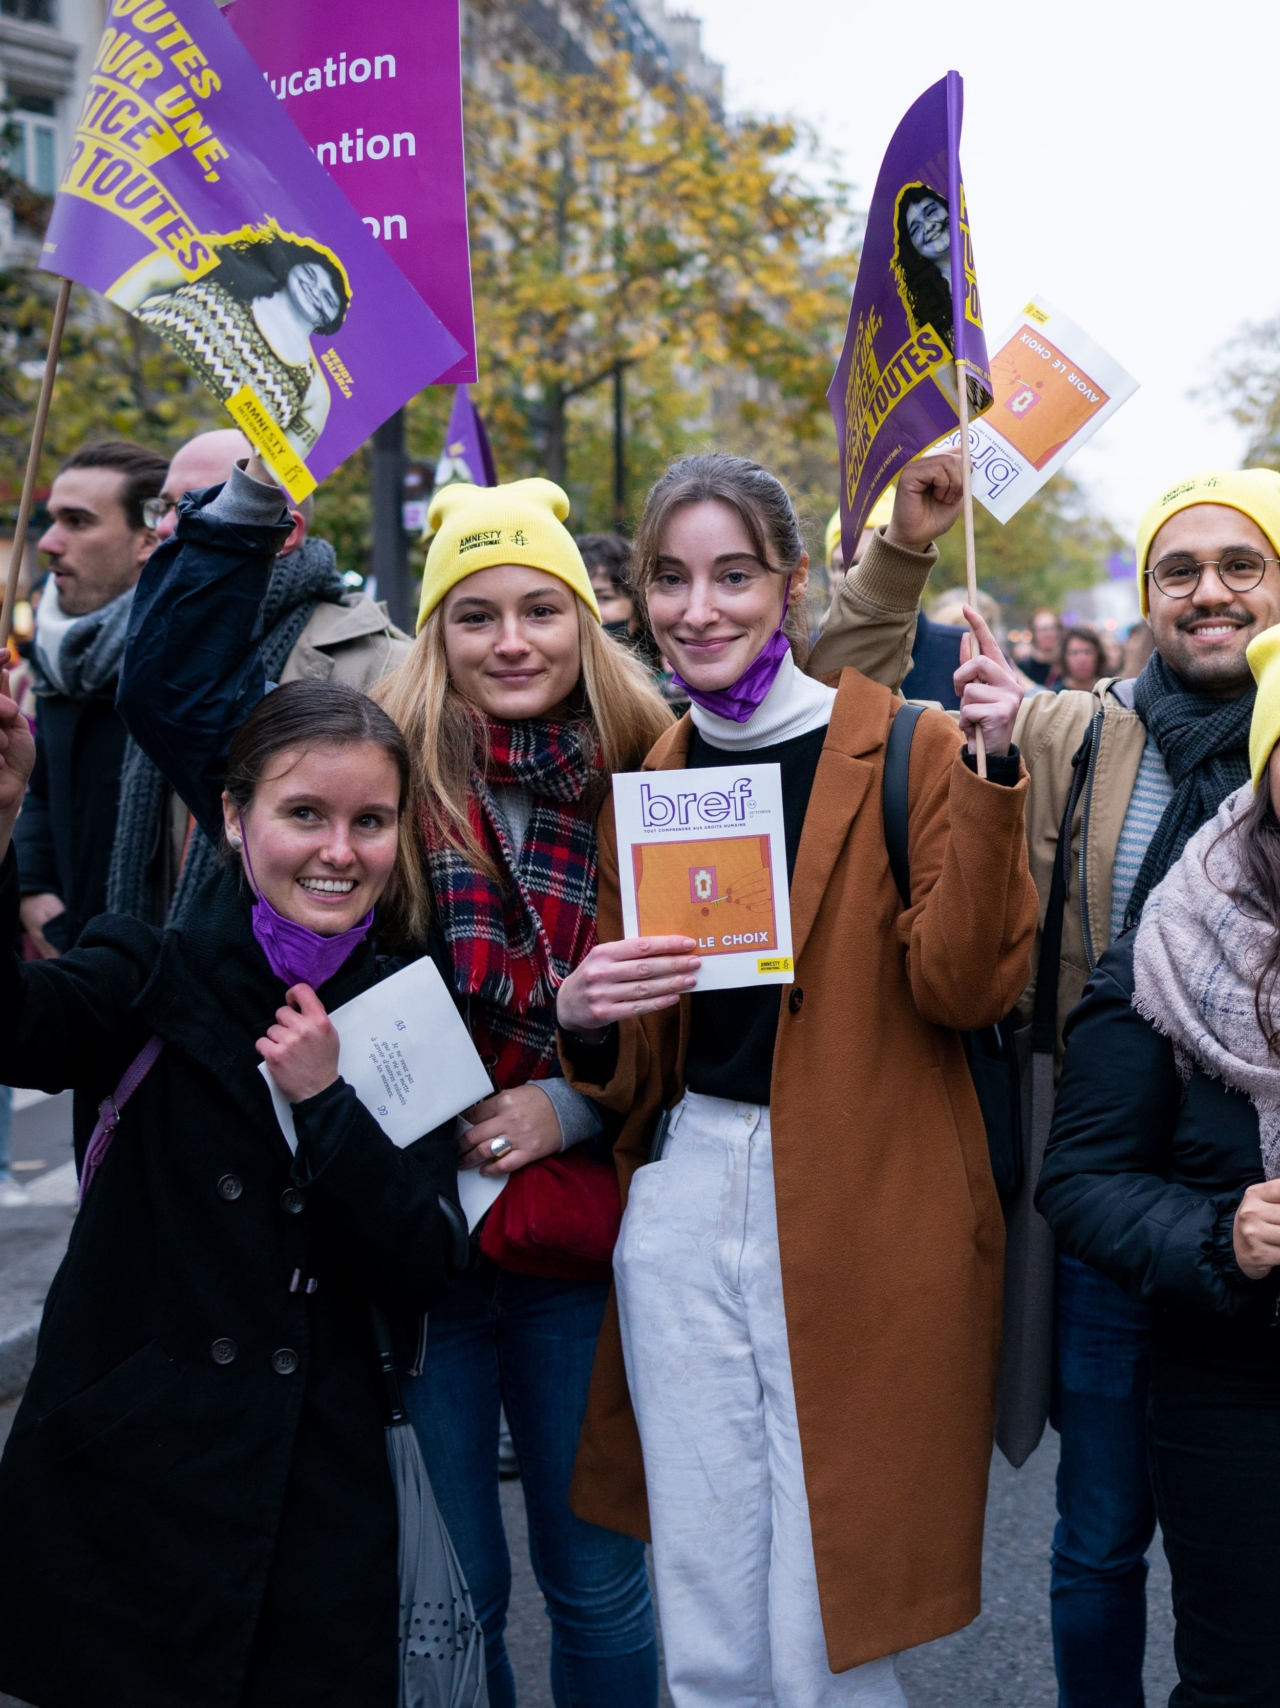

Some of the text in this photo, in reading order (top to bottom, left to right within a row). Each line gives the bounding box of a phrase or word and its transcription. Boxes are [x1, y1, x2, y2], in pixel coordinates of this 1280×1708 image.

[263, 52, 396, 100] ucation
[154, 84, 229, 182] UNE,
[310, 128, 415, 166] ntion
[77, 146, 211, 271] TOUTES
[321, 353, 353, 399] GALARZA
[327, 348, 355, 386] WENDY
[1019, 332, 1100, 404] AVOIR LE CHOIX
[237, 405, 277, 461] INTERNATIONAL
[244, 401, 286, 455] AMNESTY
[849, 331, 943, 502] POUR TOUTES
[934, 427, 1020, 500] bre
[459, 530, 502, 547] AMNESTY
[459, 539, 501, 554] INTERNATIONAL
[640, 777, 752, 828] bref
[698, 931, 769, 948] LE CHOIX
[369, 1053, 379, 1064] que
[374, 1043, 385, 1058] avoir
[393, 1083, 407, 1106] volontés
[381, 1041, 391, 1052] que
[388, 1052, 395, 1060] la
[399, 1077, 410, 1094] mette
[400, 1059, 409, 1073] veux
[405, 1073, 414, 1084] pas
